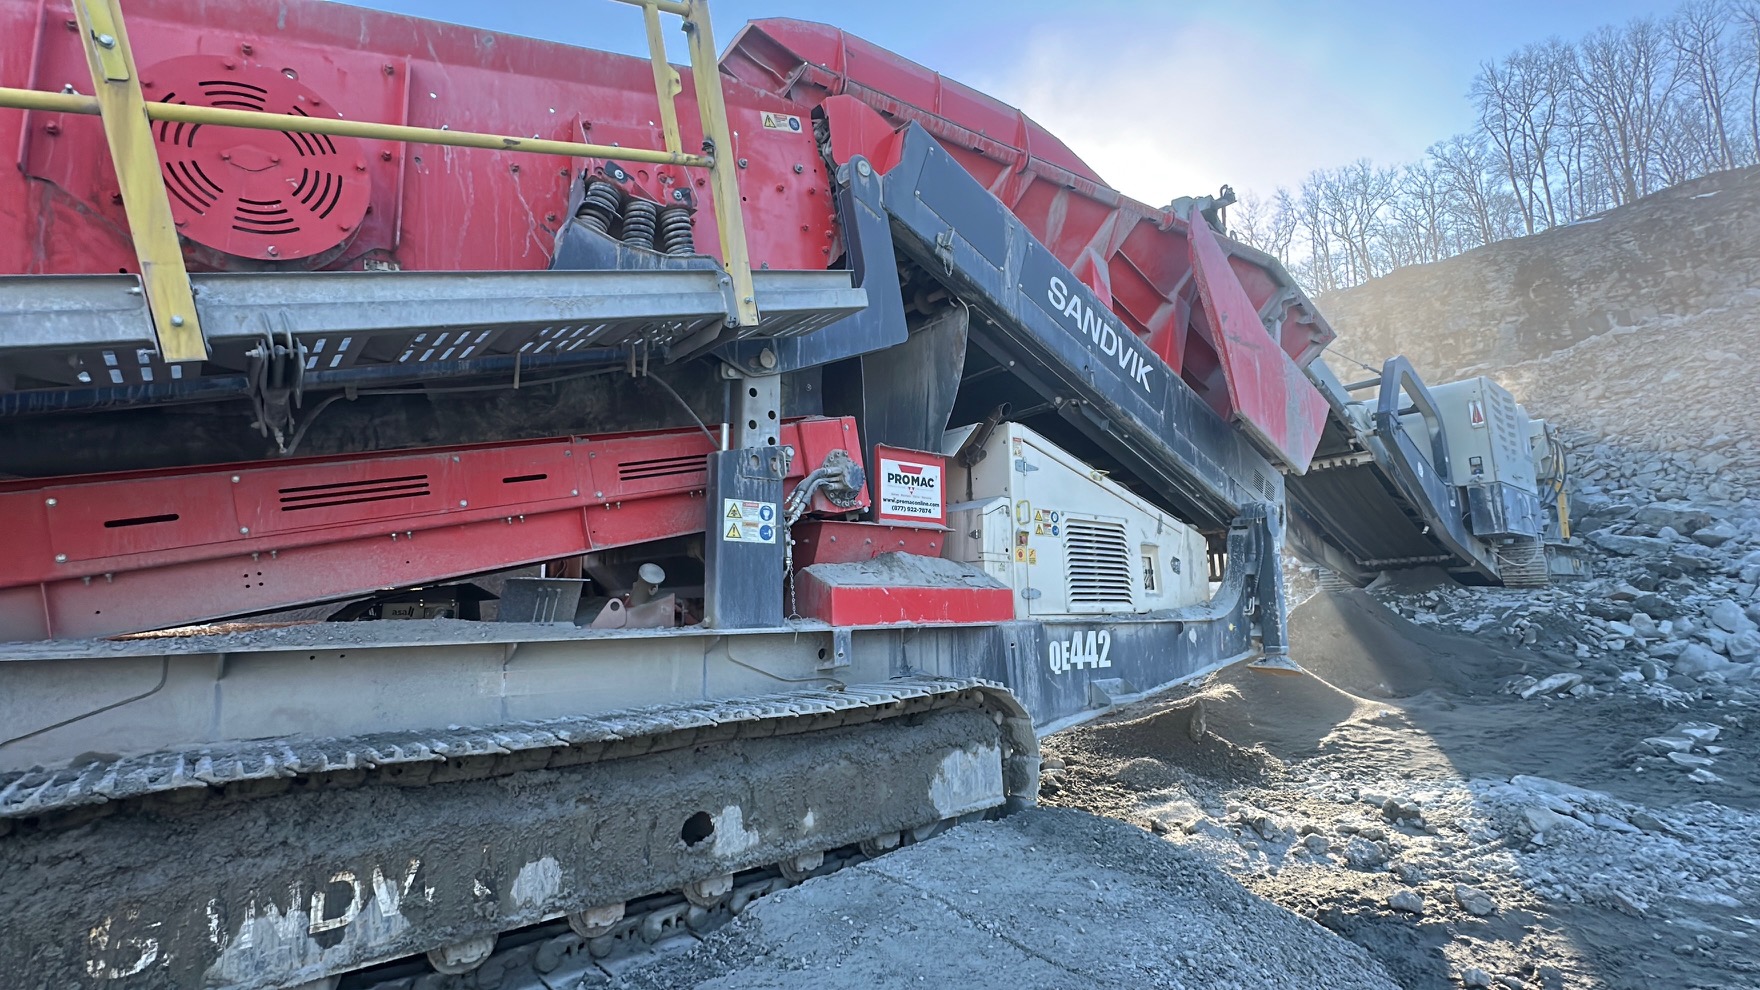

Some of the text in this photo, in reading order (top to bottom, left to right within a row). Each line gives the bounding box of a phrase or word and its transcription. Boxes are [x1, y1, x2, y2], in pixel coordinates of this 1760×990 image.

[1047, 276, 1154, 394] SANDVIK
[887, 472, 935, 488] PROMAC
[882, 497, 940, 508] www.promaconline.com
[1048, 629, 1112, 675] QE442
